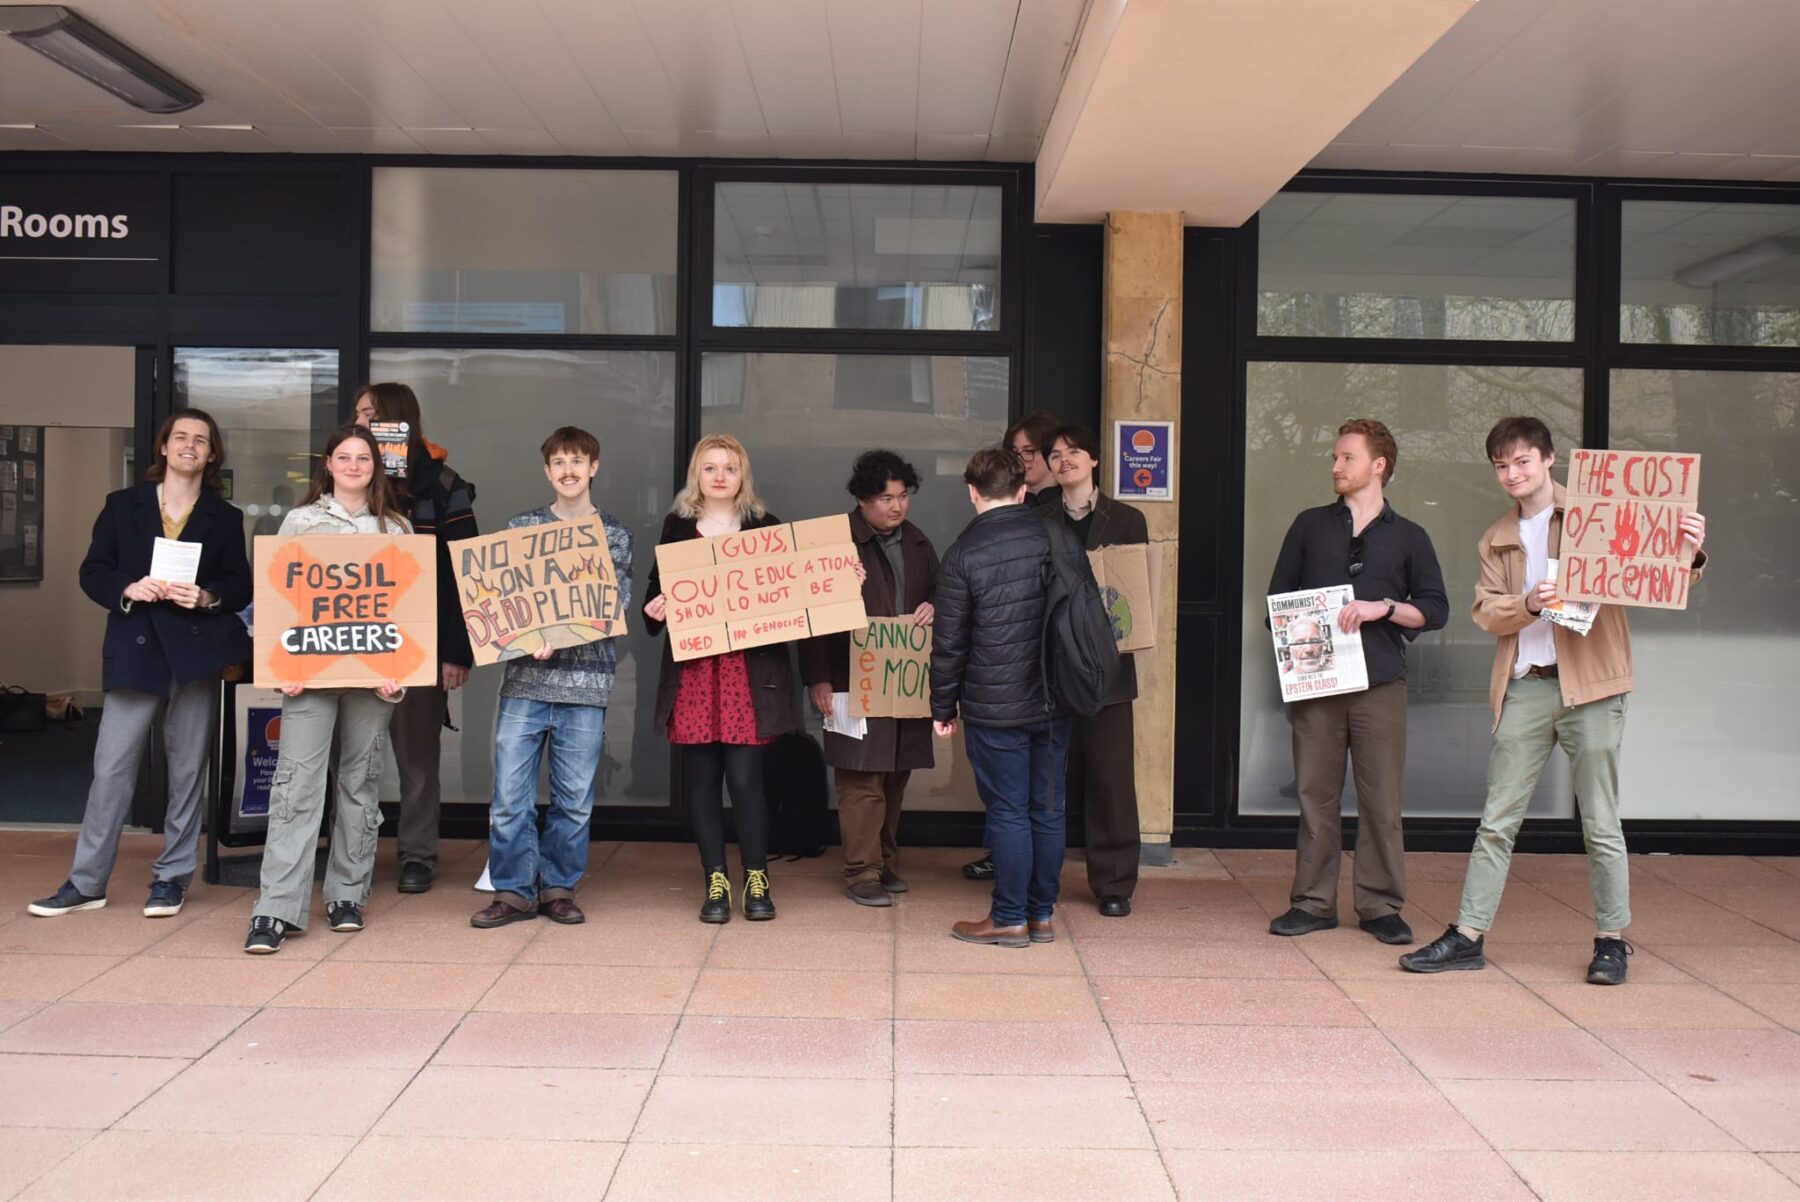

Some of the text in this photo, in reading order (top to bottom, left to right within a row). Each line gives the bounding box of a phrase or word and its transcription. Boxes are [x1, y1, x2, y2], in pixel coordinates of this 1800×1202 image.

[0, 205, 129, 239] Rooms
[1142, 462, 1157, 470] way!
[1574, 451, 1695, 498] THE COST
[461, 524, 599, 577] NO JOBS
[721, 528, 787, 558] GUYS,
[286, 561, 396, 590] FOSSIL
[500, 557, 571, 597] ON A
[671, 555, 855, 603] OUR EDUCATION
[312, 593, 389, 622] FREE
[464, 583, 623, 648] DEAD PLANET
[675, 578, 835, 623] SHOULD NOT BE
[1271, 596, 1315, 613] COMMUNIST
[280, 624, 403, 653] CAREERS
[679, 616, 805, 651] USED IN GENOCIDE
[852, 622, 933, 651] CANNO
[883, 658, 931, 700] MON
[1285, 677, 1338, 695] EPSTEIN CLASS!
[253, 757, 277, 767] Welc
